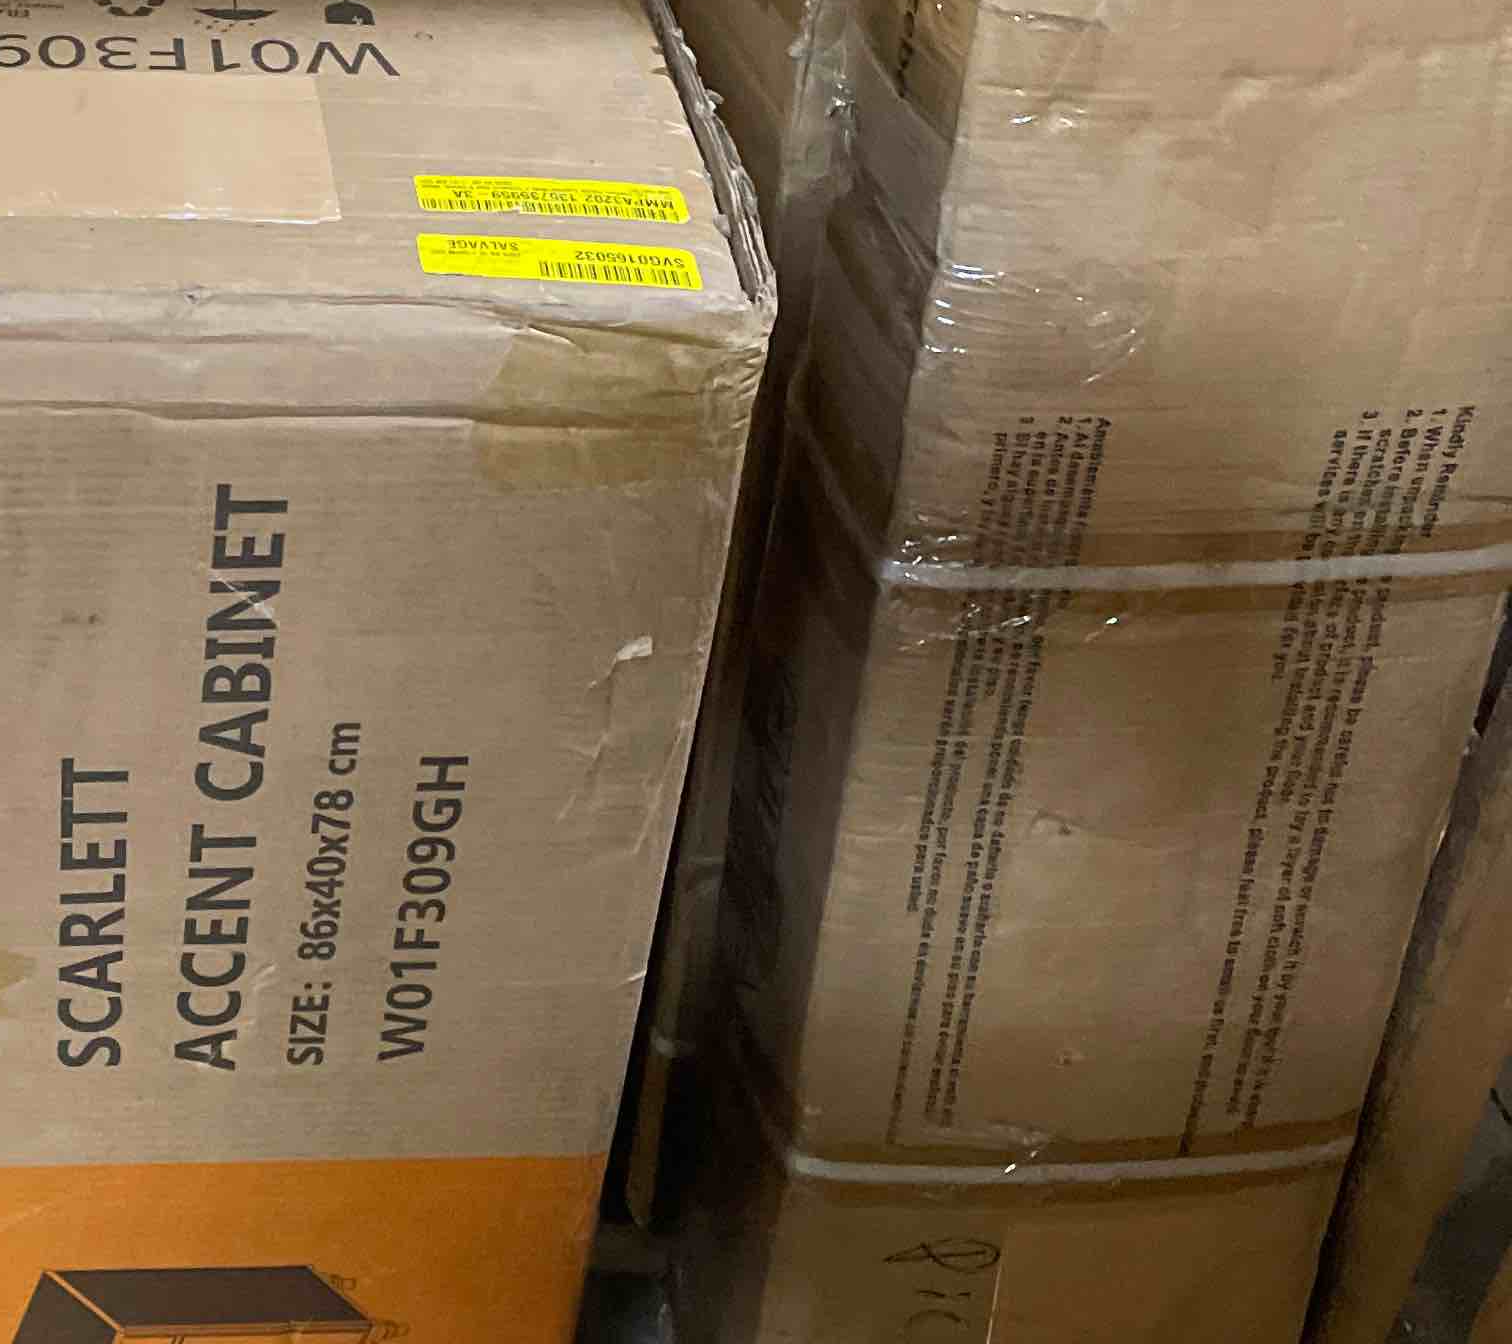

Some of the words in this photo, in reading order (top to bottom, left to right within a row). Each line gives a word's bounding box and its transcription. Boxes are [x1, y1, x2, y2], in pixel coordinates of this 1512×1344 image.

[447, 238, 520, 252] SALVAGE
[193, 482, 289, 801] CABINET
[328, 721, 362, 776] cm
[57, 757, 129, 1069] SCARLETT
[174, 822, 257, 1072] ACCENT
[296, 789, 355, 961] 86x40x78
[377, 754, 470, 1062] W01F309GH
[286, 978, 333, 1066] SIZE:
